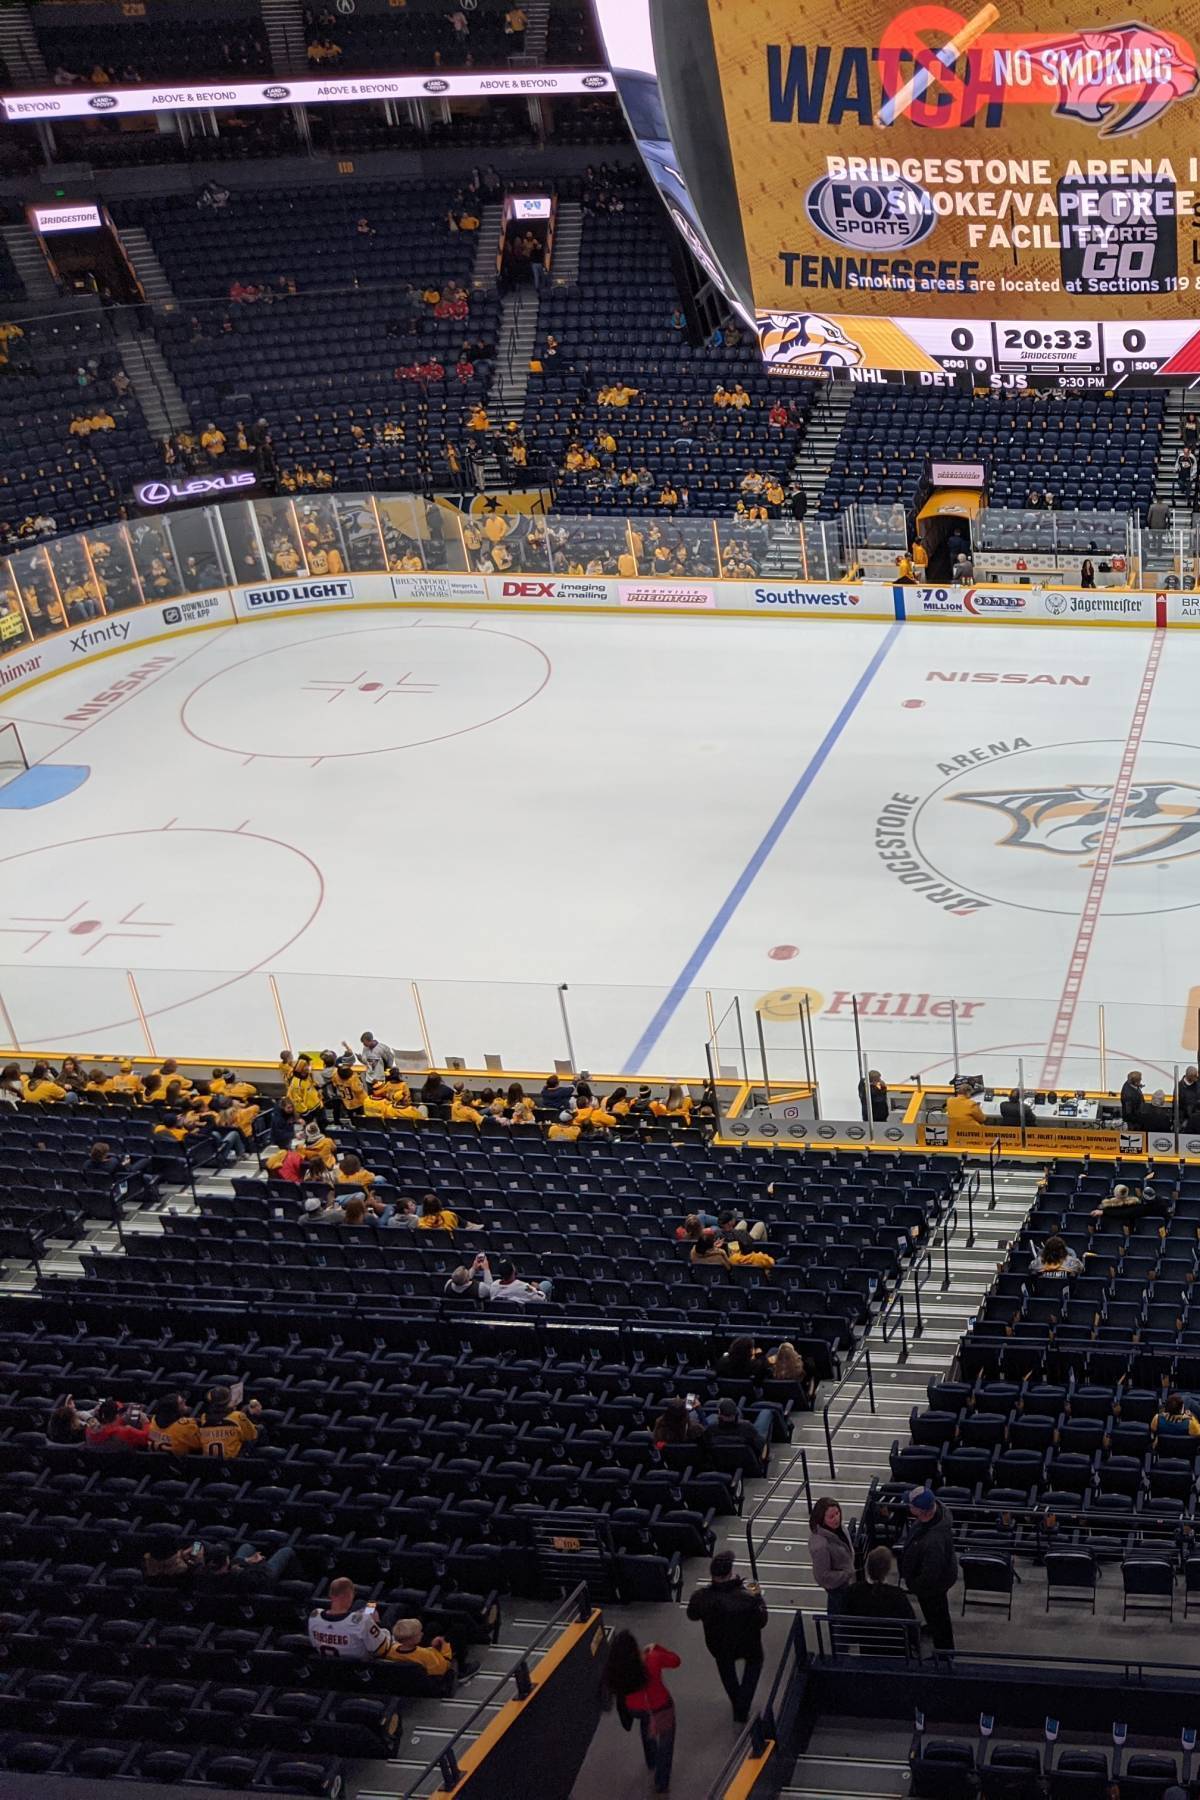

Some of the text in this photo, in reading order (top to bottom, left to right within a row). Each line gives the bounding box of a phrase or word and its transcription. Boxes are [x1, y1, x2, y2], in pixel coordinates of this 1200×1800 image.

[993, 48, 1173, 86] NO SMOKING
[317, 83, 399, 96] ABOVE & BEYOND
[480, 79, 558, 89] ABOVE & BEYOND
[767, 44, 1007, 128] WATCH
[151, 91, 237, 104] ABOVE & BEYOND
[8, 101, 61, 112] & BEYOND
[826, 156, 1051, 184] BRIDGESTONE
[1064, 158, 1177, 184] ARENA
[832, 184, 905, 220] FOX
[889, 191, 1195, 218] SMOKE/VAPE FREE
[40, 213, 97, 225] BRIDGESTONE
[836, 220, 910, 235] SPORTS
[969, 224, 1116, 249] FACILITY
[1081, 244, 1155, 279] GO
[849, 272, 915, 295] Smoking
[921, 278, 964, 291] areas
[969, 278, 996, 292] are
[1001, 277, 1060, 292] located
[1066, 279, 1081, 292] at
[1088, 277, 1159, 292] Sections
[1164, 276, 1189, 291] 119
[951, 328, 974, 351] 0
[1004, 329, 1092, 350] 20:33
[1122, 329, 1146, 353] 0
[1021, 351, 1077, 360] BRIDGESTONE
[767, 366, 829, 378] PREDATORS
[942, 360, 987, 372] SOG 0
[1112, 361, 1158, 373] 0 SOG
[850, 368, 887, 384] NHL
[920, 371, 957, 387] DET
[990, 375, 1028, 388] SJS
[1059, 377, 1105, 387] 9:30 PM
[171, 472, 256, 496] LEXUS
[250, 583, 349, 607] BUD LIGHT
[503, 581, 557, 598] DEX
[560, 582, 606, 592] imaging
[916, 588, 948, 602] $70
[567, 591, 608, 600] mailing
[627, 592, 707, 603] PREDATORS
[755, 588, 847, 606] Southwest
[181, 597, 219, 612] DOWNLOAD
[924, 602, 962, 610] MILLION
[1070, 597, 1142, 614] Jägermeister
[183, 608, 210, 622] THE APP
[69, 620, 131, 653] xfinity
[926, 671, 1091, 686] NISSAN
[64, 656, 176, 720] NISSAN
[936, 737, 1032, 777] ARENA
[873, 791, 991, 916] BRIDGESTONE
[824, 991, 985, 1018] Hiller
